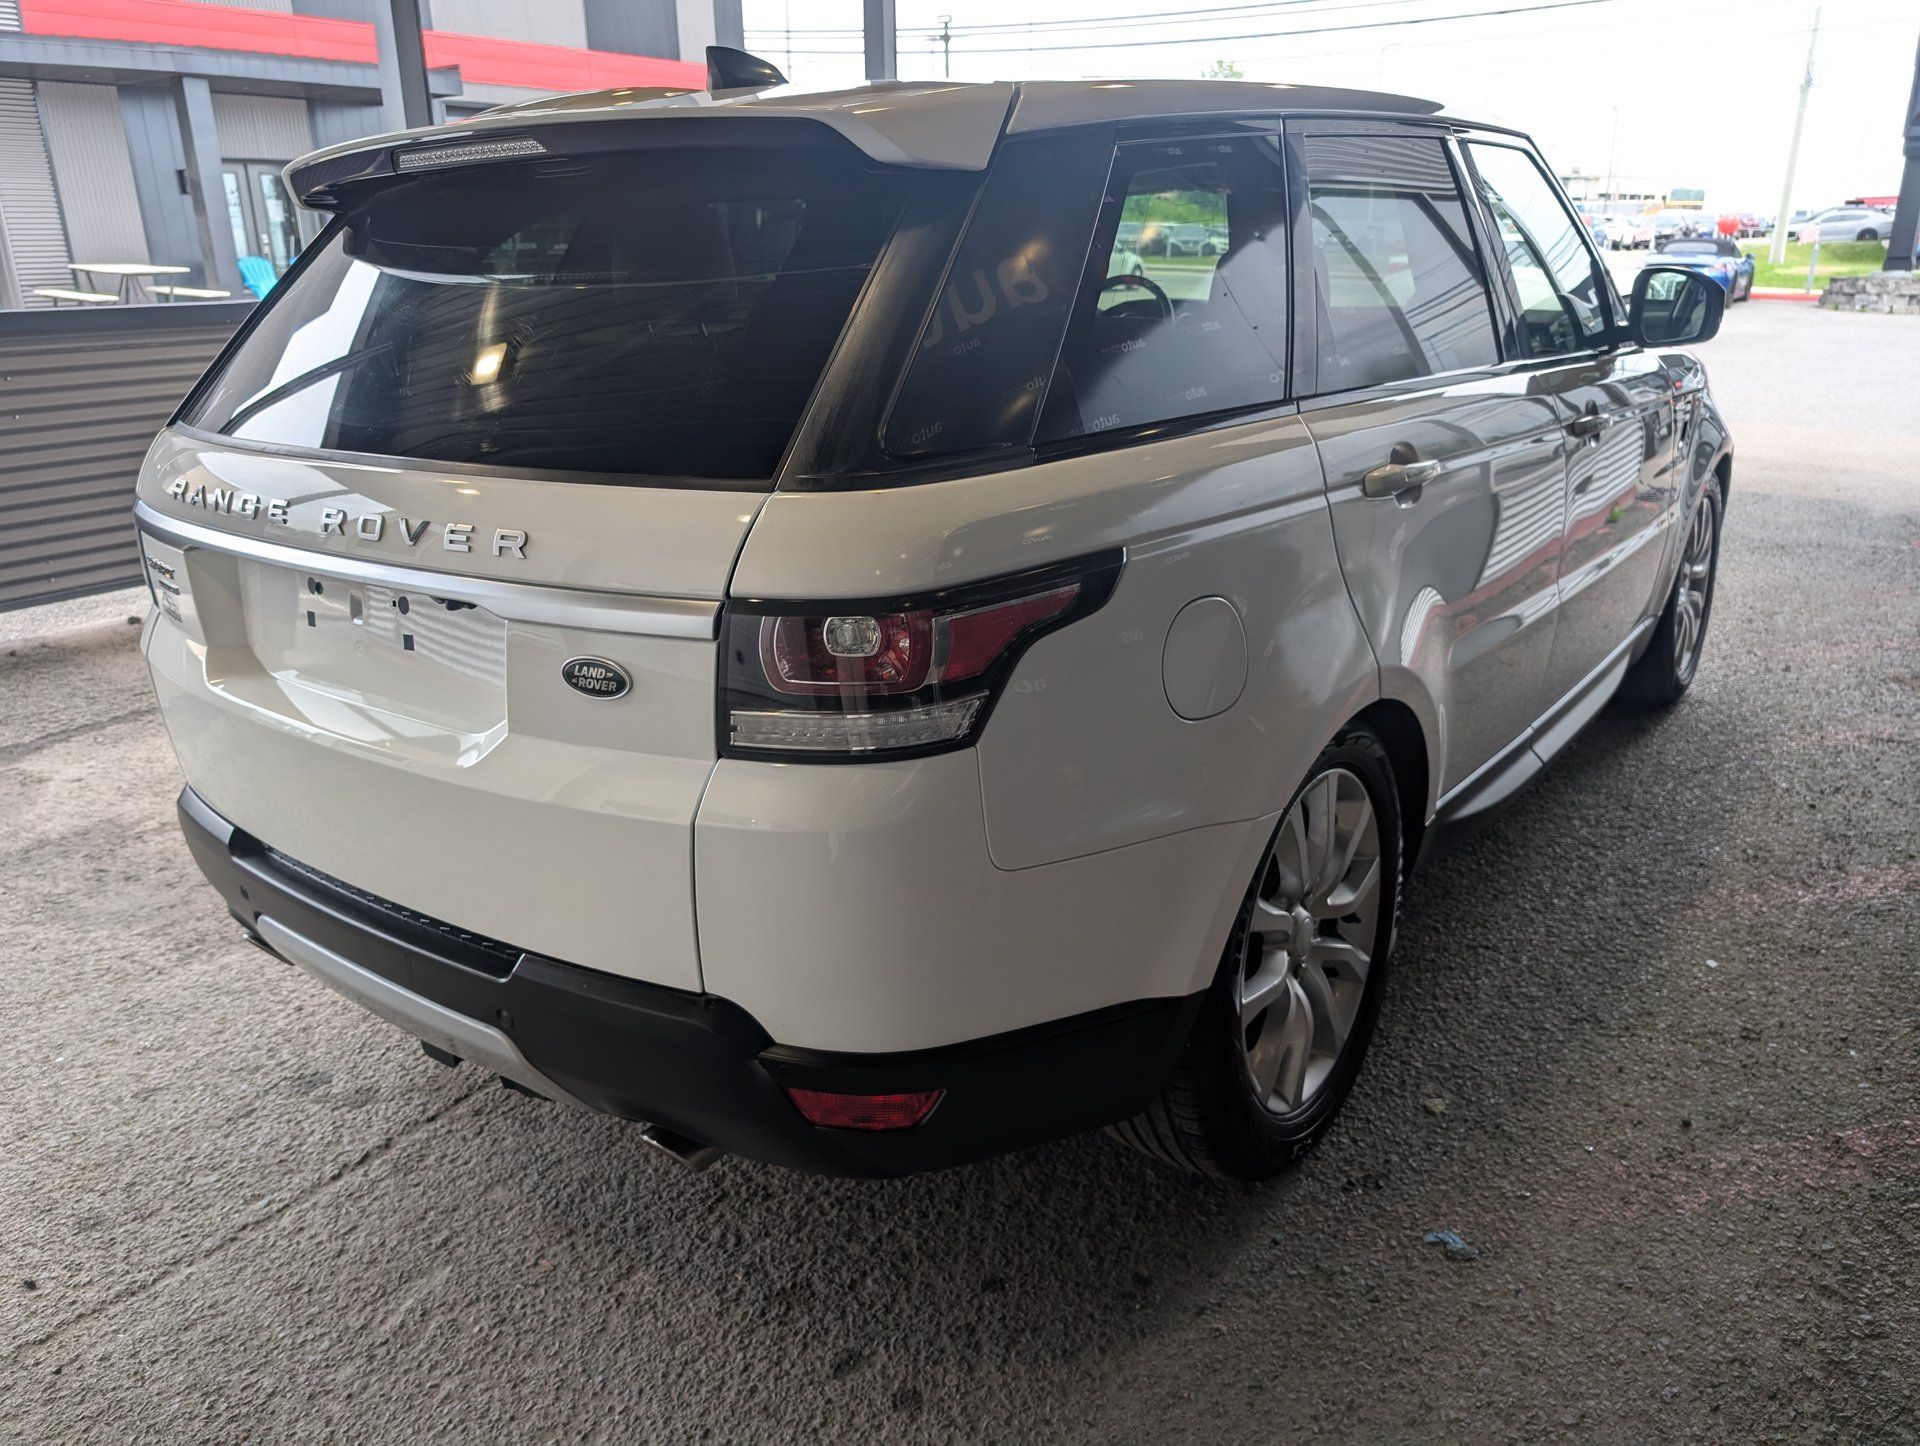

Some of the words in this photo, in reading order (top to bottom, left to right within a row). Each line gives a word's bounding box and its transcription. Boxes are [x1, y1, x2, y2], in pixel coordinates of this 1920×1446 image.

[171, 478, 291, 525] RANGE
[320, 507, 528, 560] ROVER
[574, 664, 606, 679] LAND
[577, 677, 617, 692] ROVER
